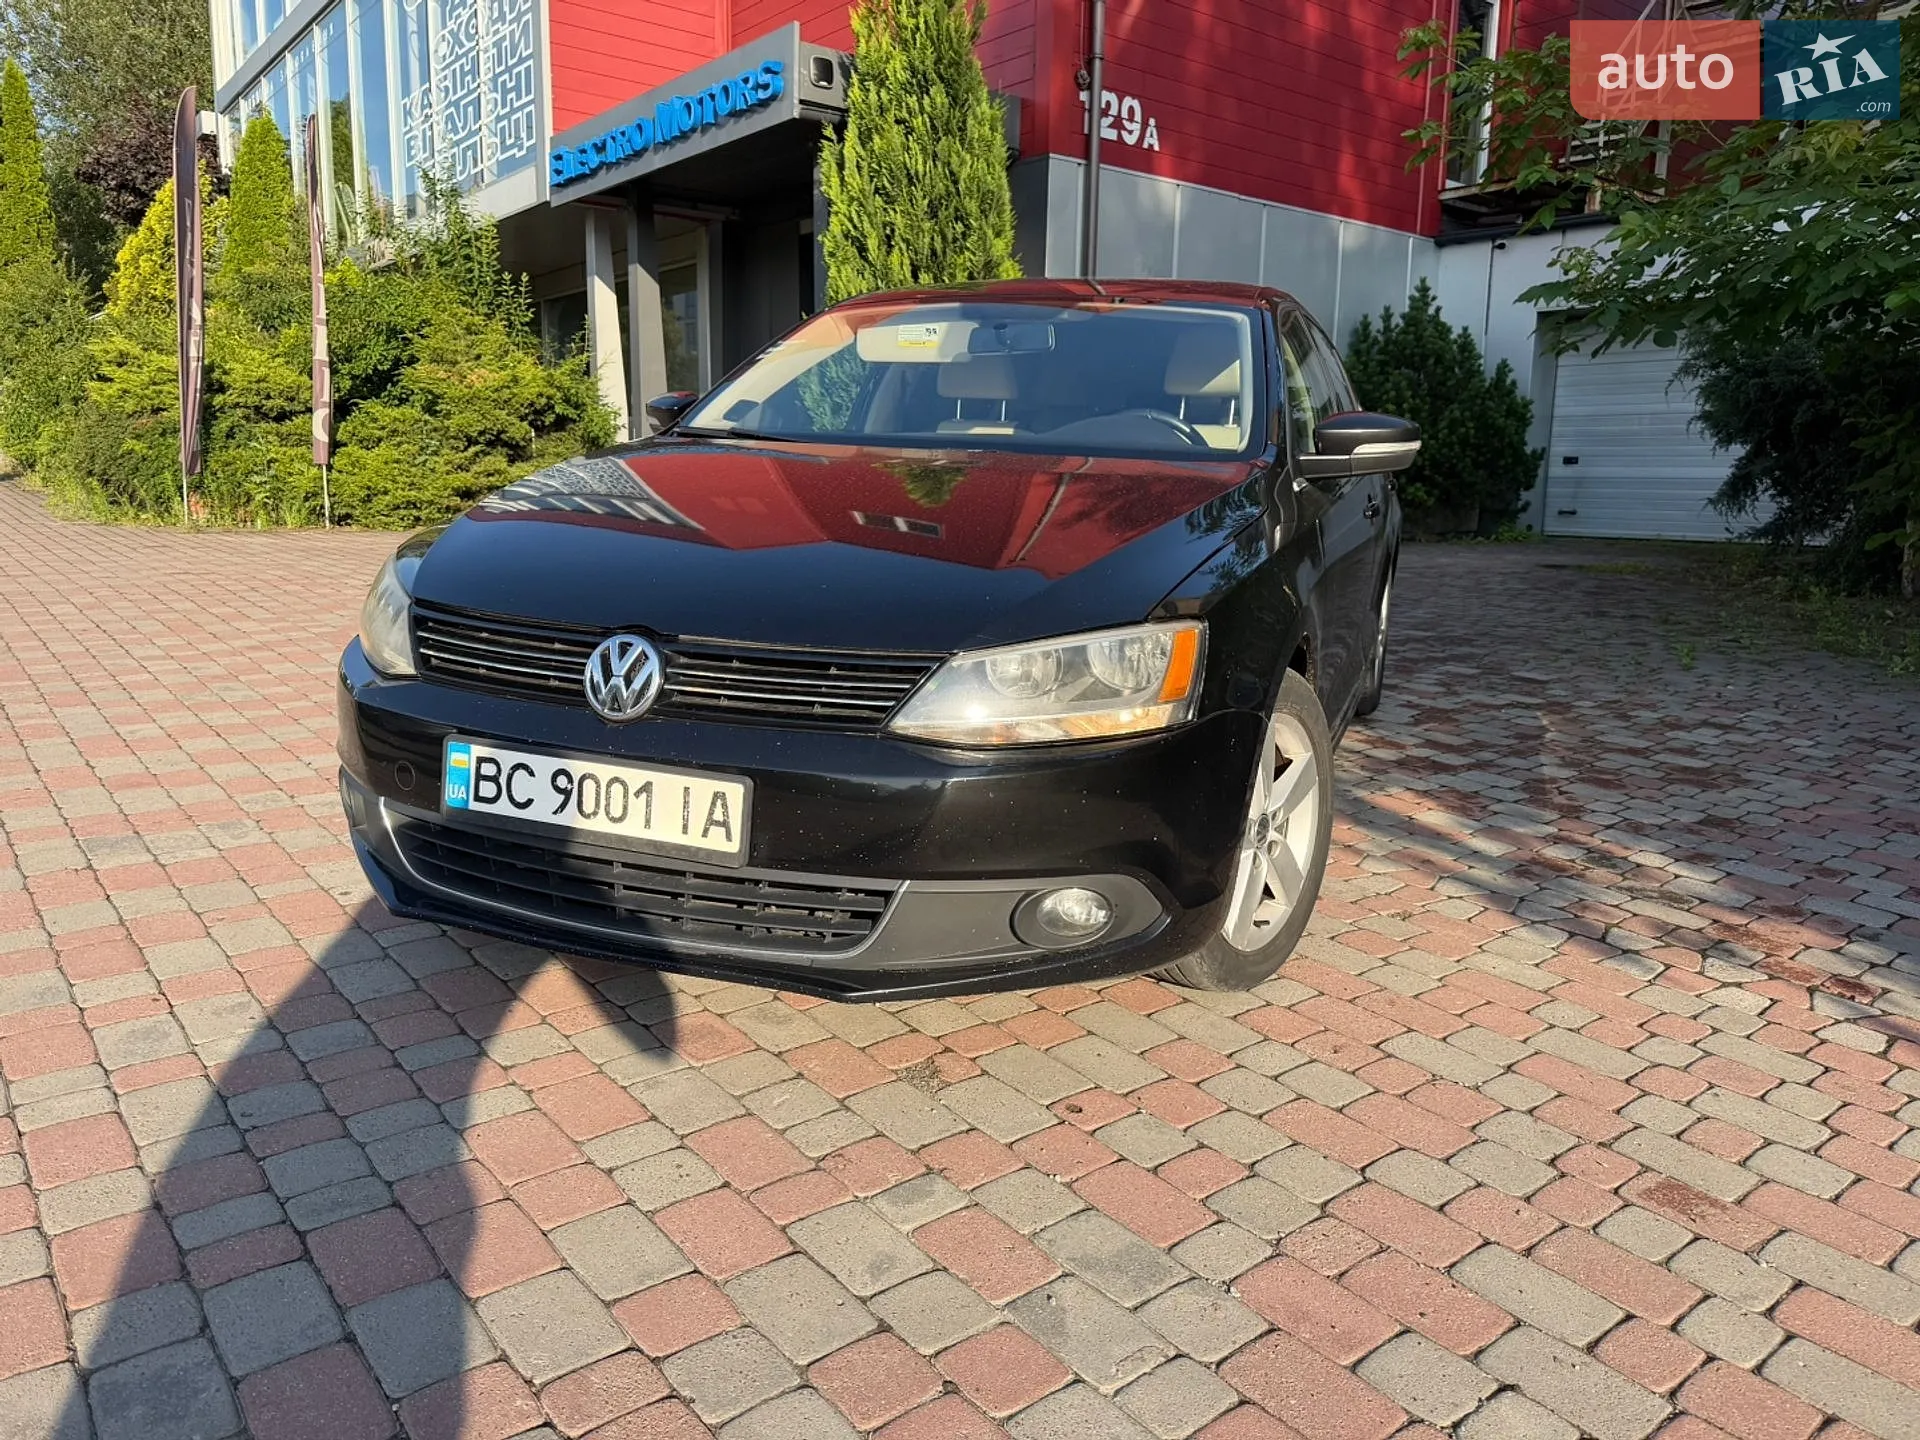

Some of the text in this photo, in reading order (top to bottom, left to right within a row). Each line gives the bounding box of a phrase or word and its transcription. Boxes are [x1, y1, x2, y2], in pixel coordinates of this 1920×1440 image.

[401, 12, 534, 132] КАБІНЕТИ
[449, 783, 467, 801] UA
[472, 755, 734, 843] BC 9001 IA
